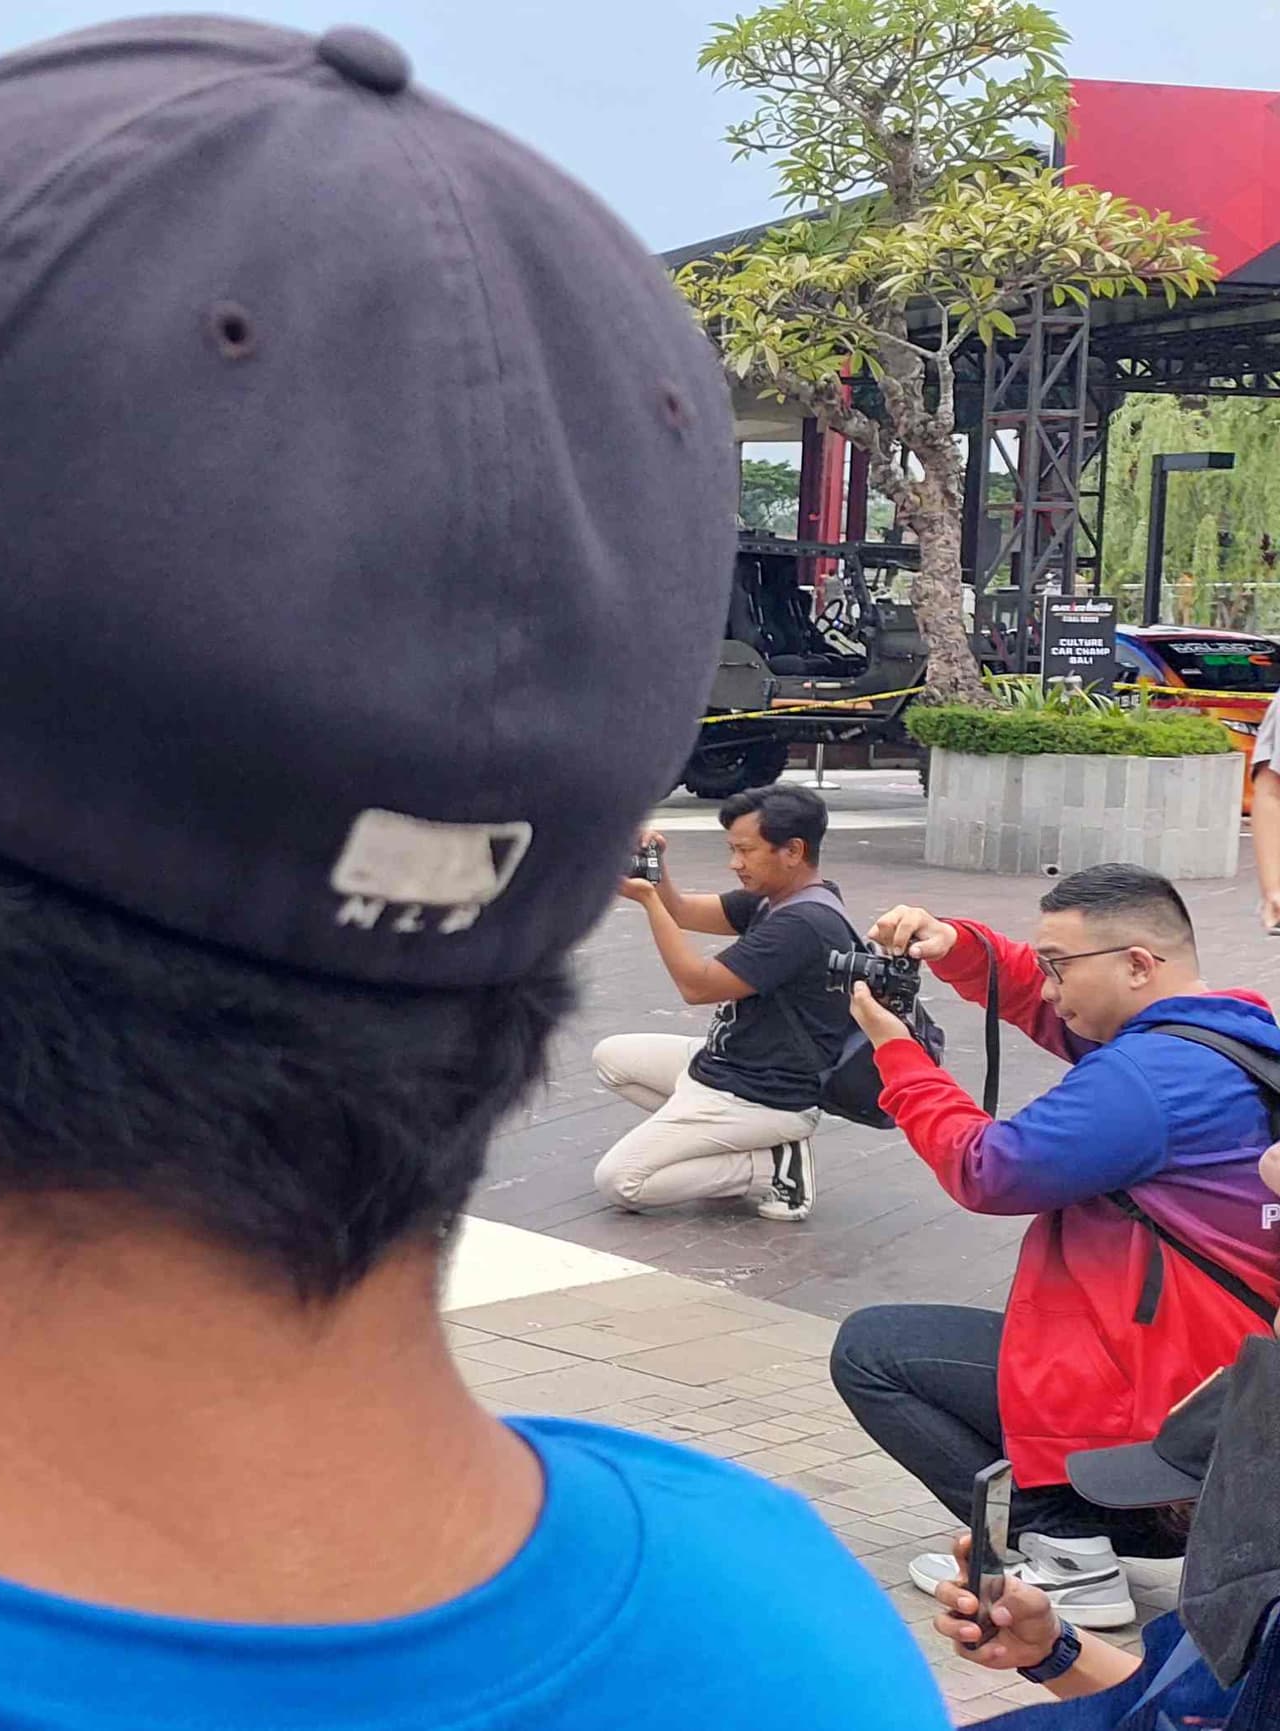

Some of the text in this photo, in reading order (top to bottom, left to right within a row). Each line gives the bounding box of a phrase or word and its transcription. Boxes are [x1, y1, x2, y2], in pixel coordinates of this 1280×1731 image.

[1059, 638, 1104, 647] CULTURE
[1051, 647, 1111, 656] CAR CHAMP
[1069, 656, 1094, 665] BALI
[1262, 1203, 1280, 1230] P
